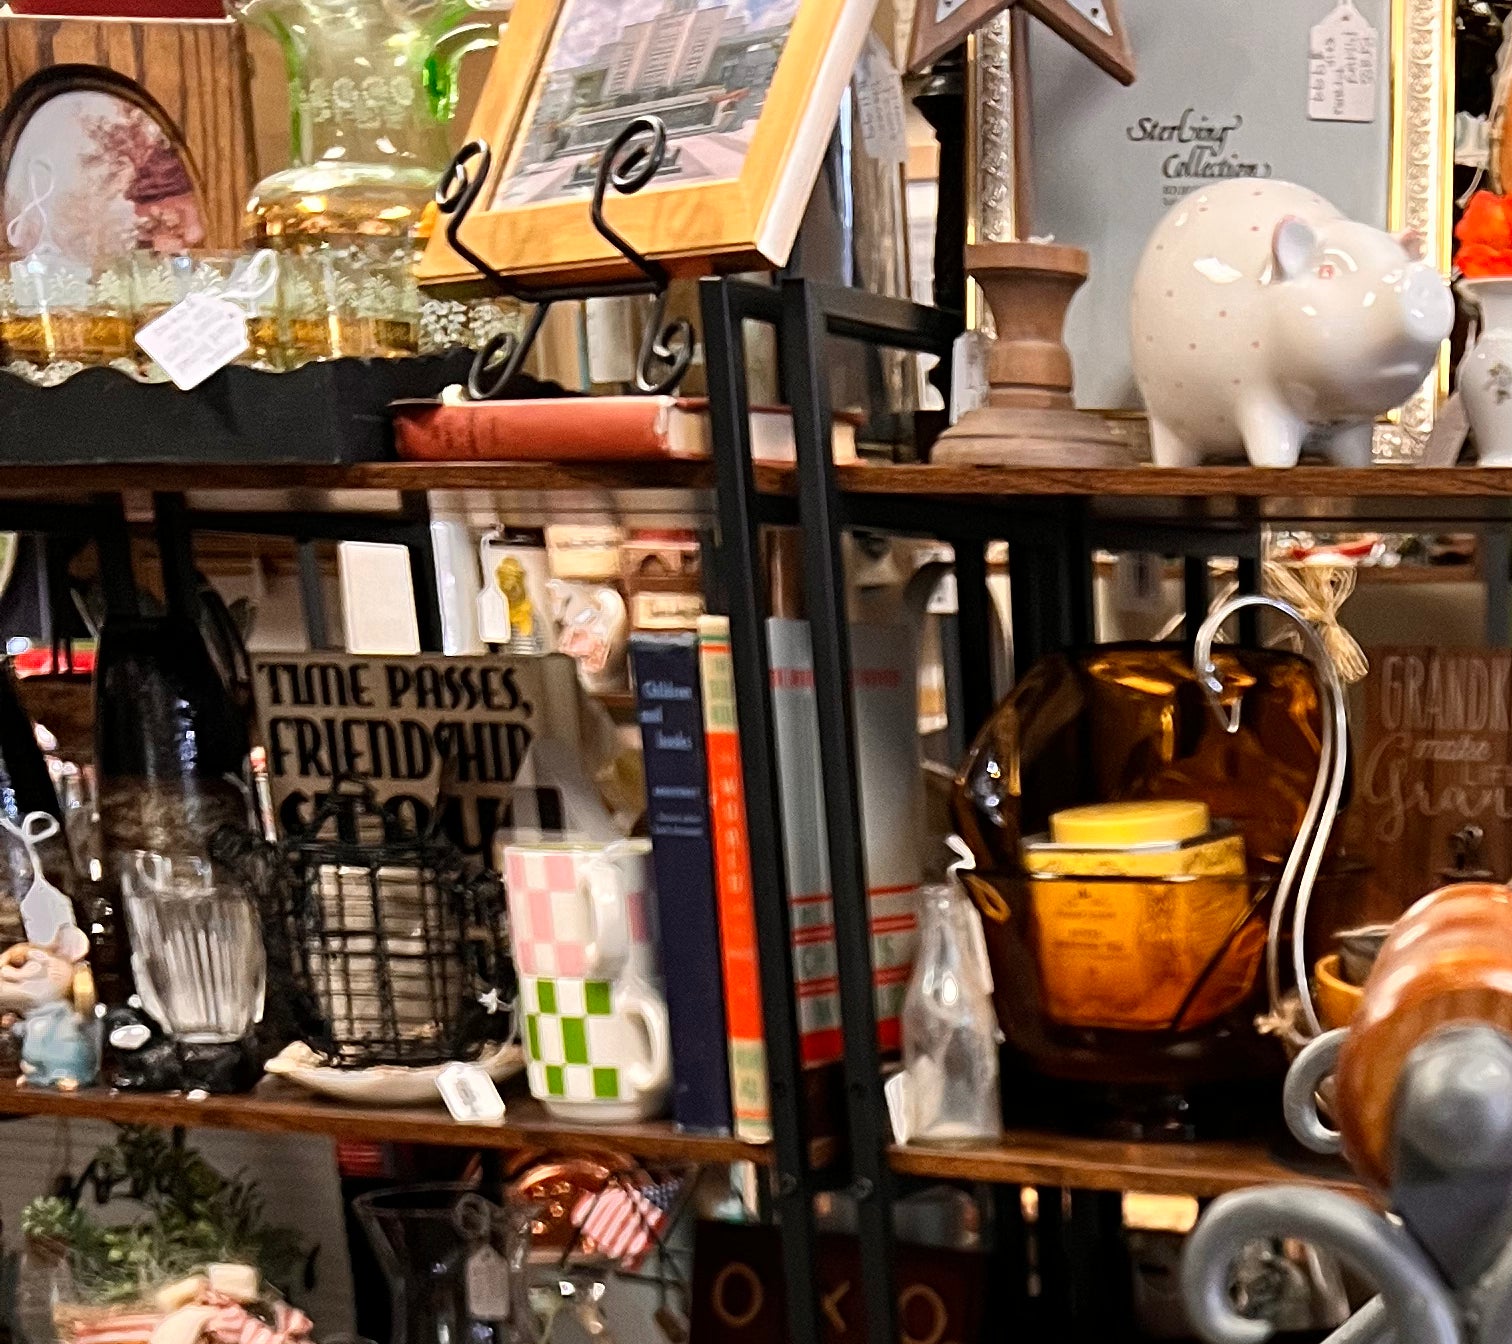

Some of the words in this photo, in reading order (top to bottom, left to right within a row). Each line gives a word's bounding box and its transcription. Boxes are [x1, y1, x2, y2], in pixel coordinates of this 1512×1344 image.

[1126, 108, 1243, 157] Sterling
[1162, 145, 1273, 178] Collection
[256, 662, 374, 707] TIME
[385, 663, 534, 719] PASSES,
